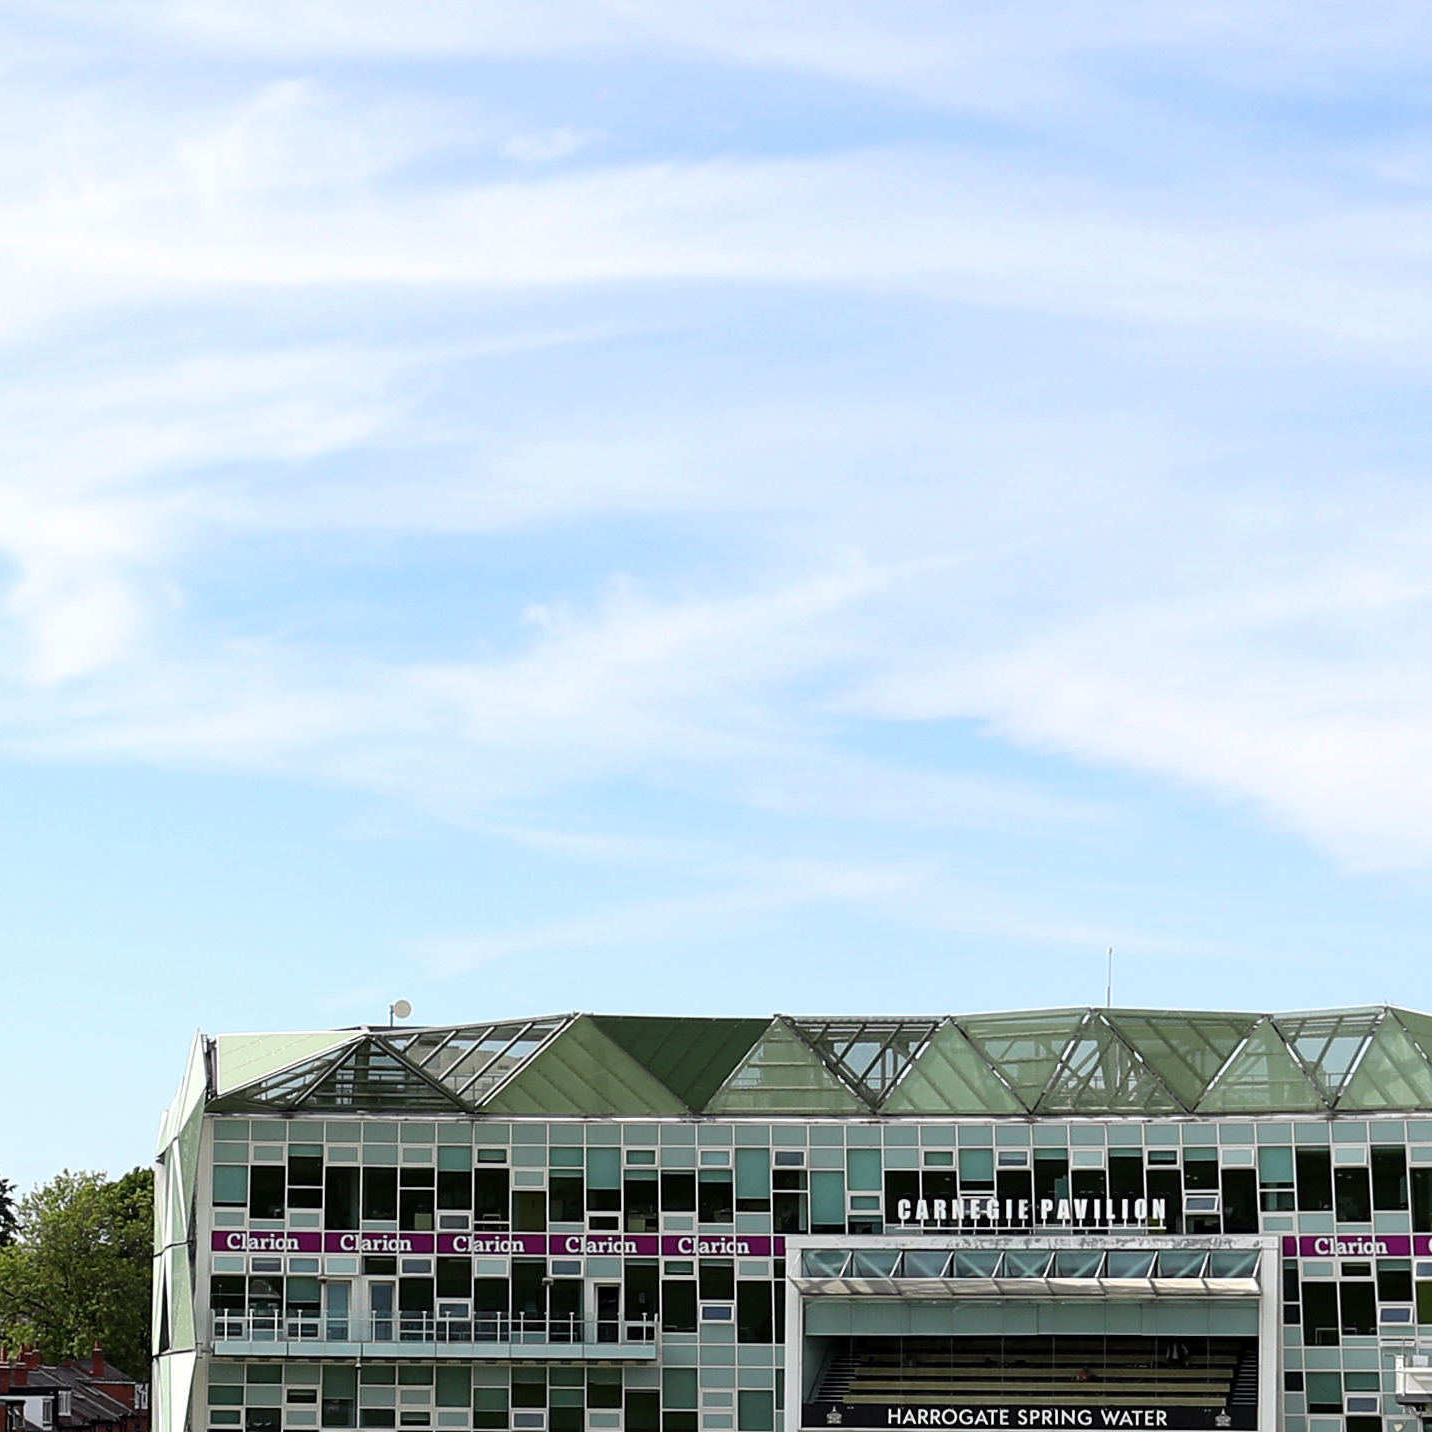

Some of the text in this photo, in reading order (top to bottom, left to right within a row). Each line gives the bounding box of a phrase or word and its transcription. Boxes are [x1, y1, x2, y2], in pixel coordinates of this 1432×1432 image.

[897, 1198, 1166, 1220] CARNEGIE PAVILION
[227, 1233, 299, 1251] Clarion
[340, 1234, 412, 1252] Clarion
[453, 1235, 524, 1253] Clarion
[565, 1236, 637, 1253] Clarion
[677, 1237, 750, 1254] Clarion
[1314, 1237, 1388, 1255] Clarion
[887, 1408, 1168, 1427] HARROGATE SPRING WATER
